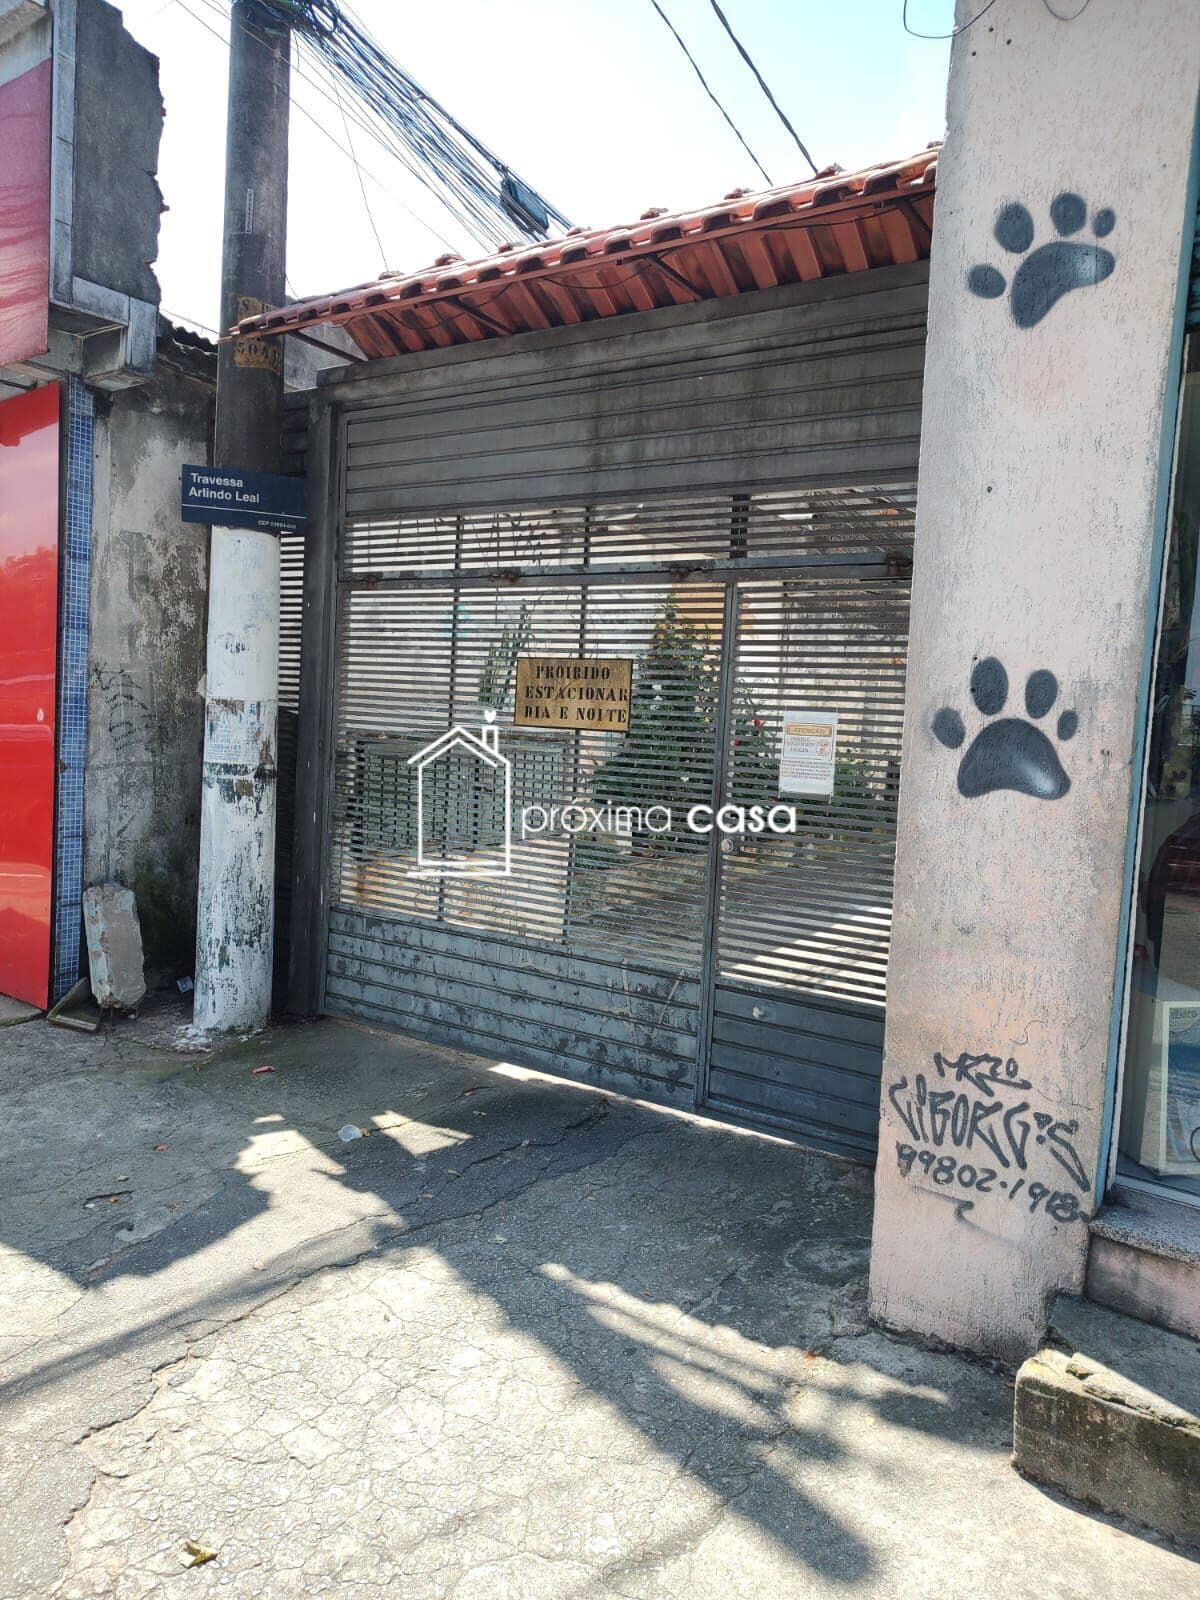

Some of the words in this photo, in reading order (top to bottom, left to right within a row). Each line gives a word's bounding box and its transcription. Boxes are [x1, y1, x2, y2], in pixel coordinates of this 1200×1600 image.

[190, 472, 244, 488] Travessa
[188, 486, 232, 500] Arlindo
[235, 491, 260, 504] Leal
[535, 665, 611, 680] PROIBIDO
[525, 685, 628, 702] ESTACIONAR
[524, 705, 550, 719] DIA
[560, 706, 568, 719] E
[576, 707, 627, 723] NOITE
